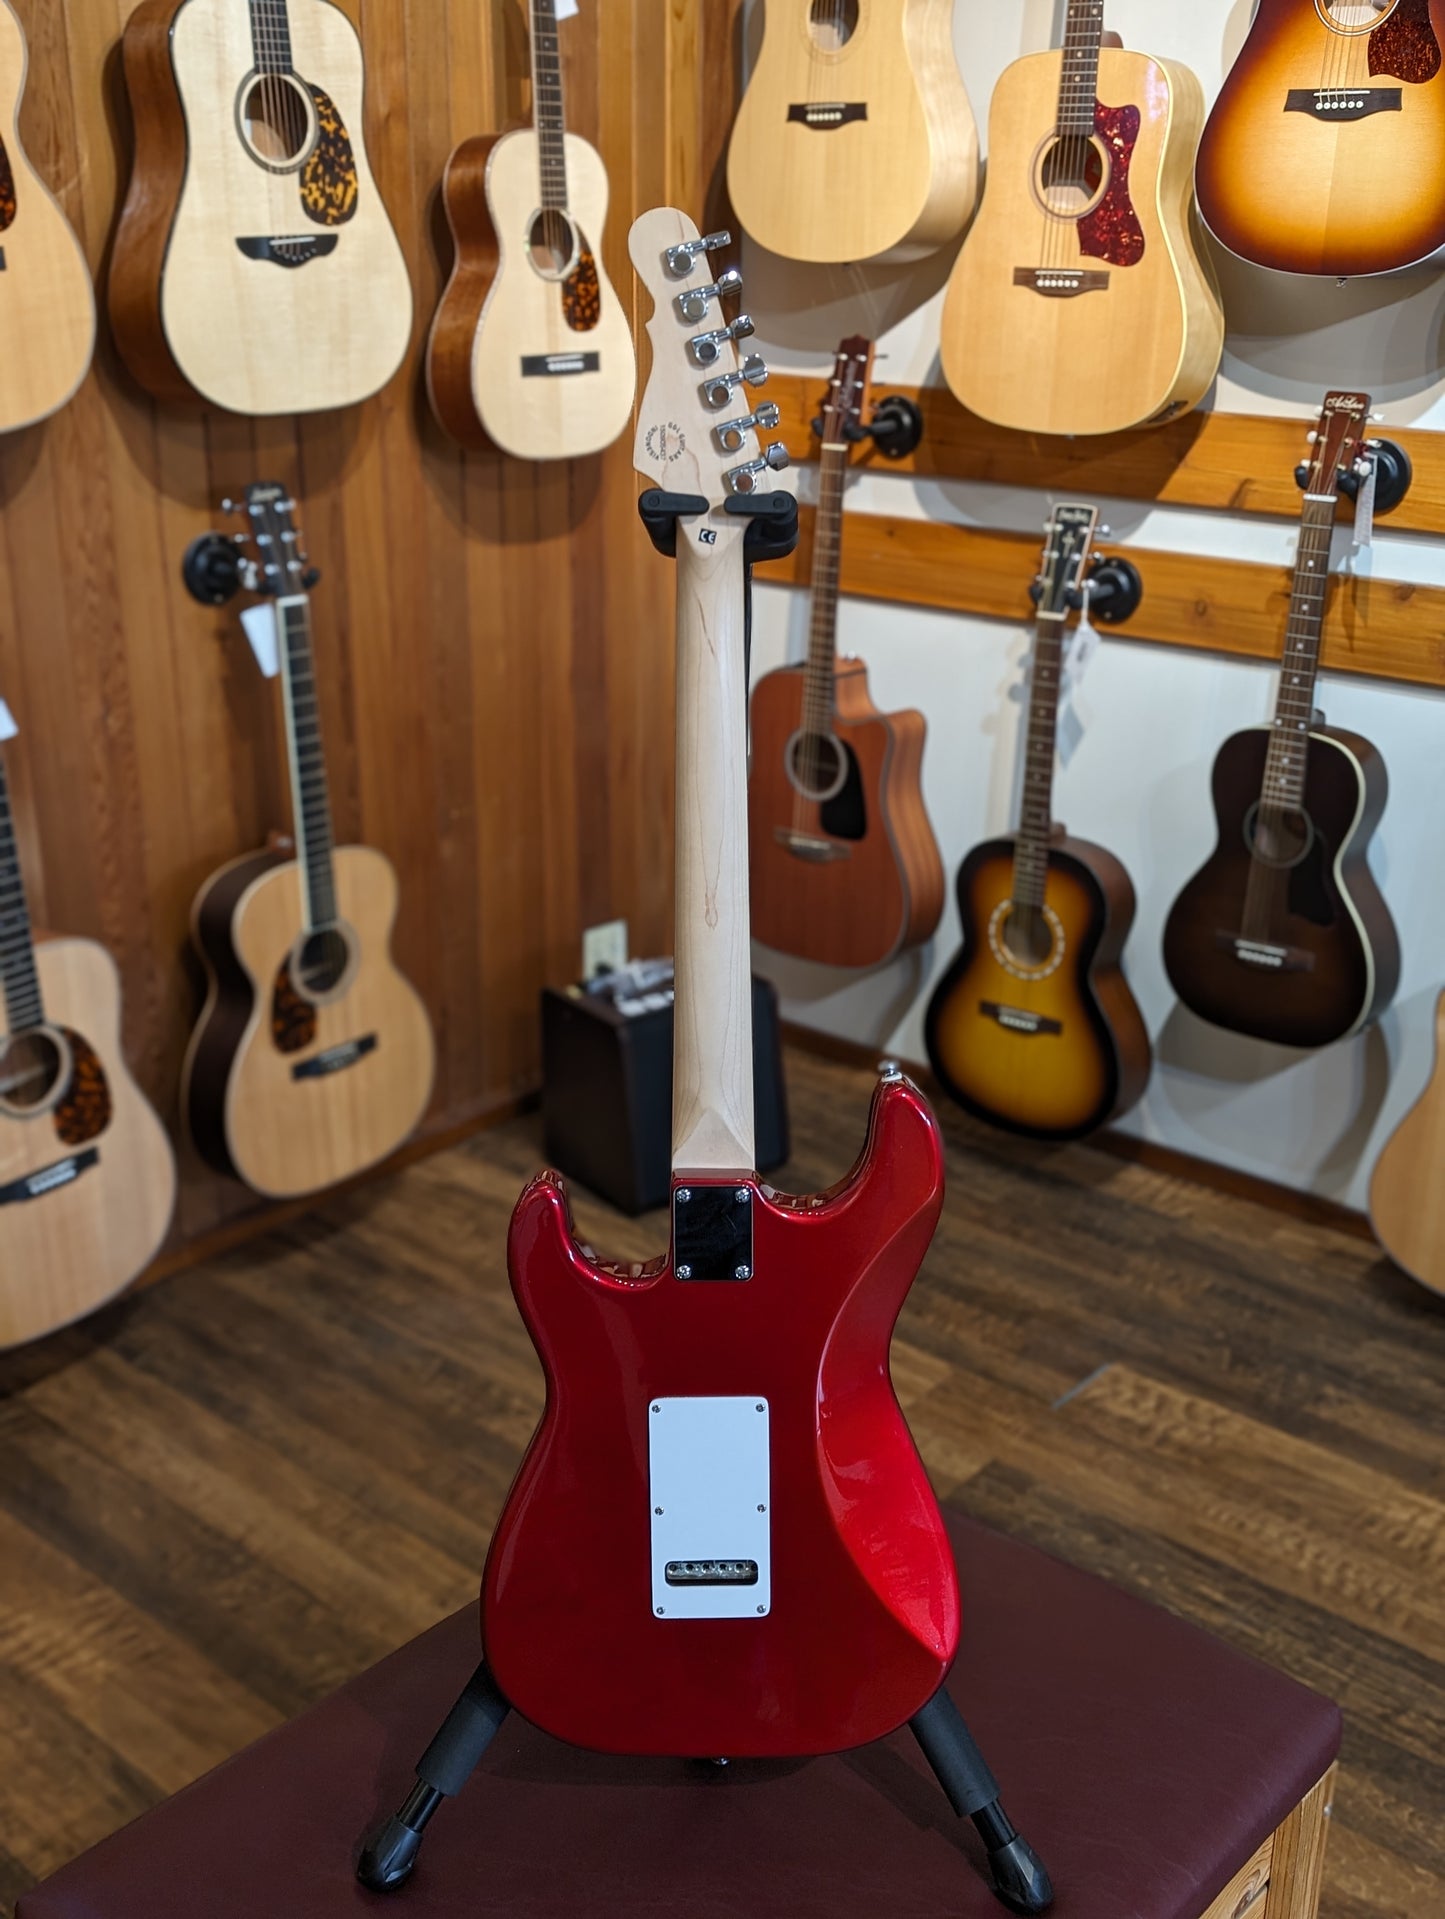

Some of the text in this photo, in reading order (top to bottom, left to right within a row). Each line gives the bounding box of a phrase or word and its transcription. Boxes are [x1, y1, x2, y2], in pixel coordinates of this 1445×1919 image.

[645, 424, 659, 461] INDONESIA
[668, 433, 686, 462] GUITARS
[700, 530, 716, 544] CE
